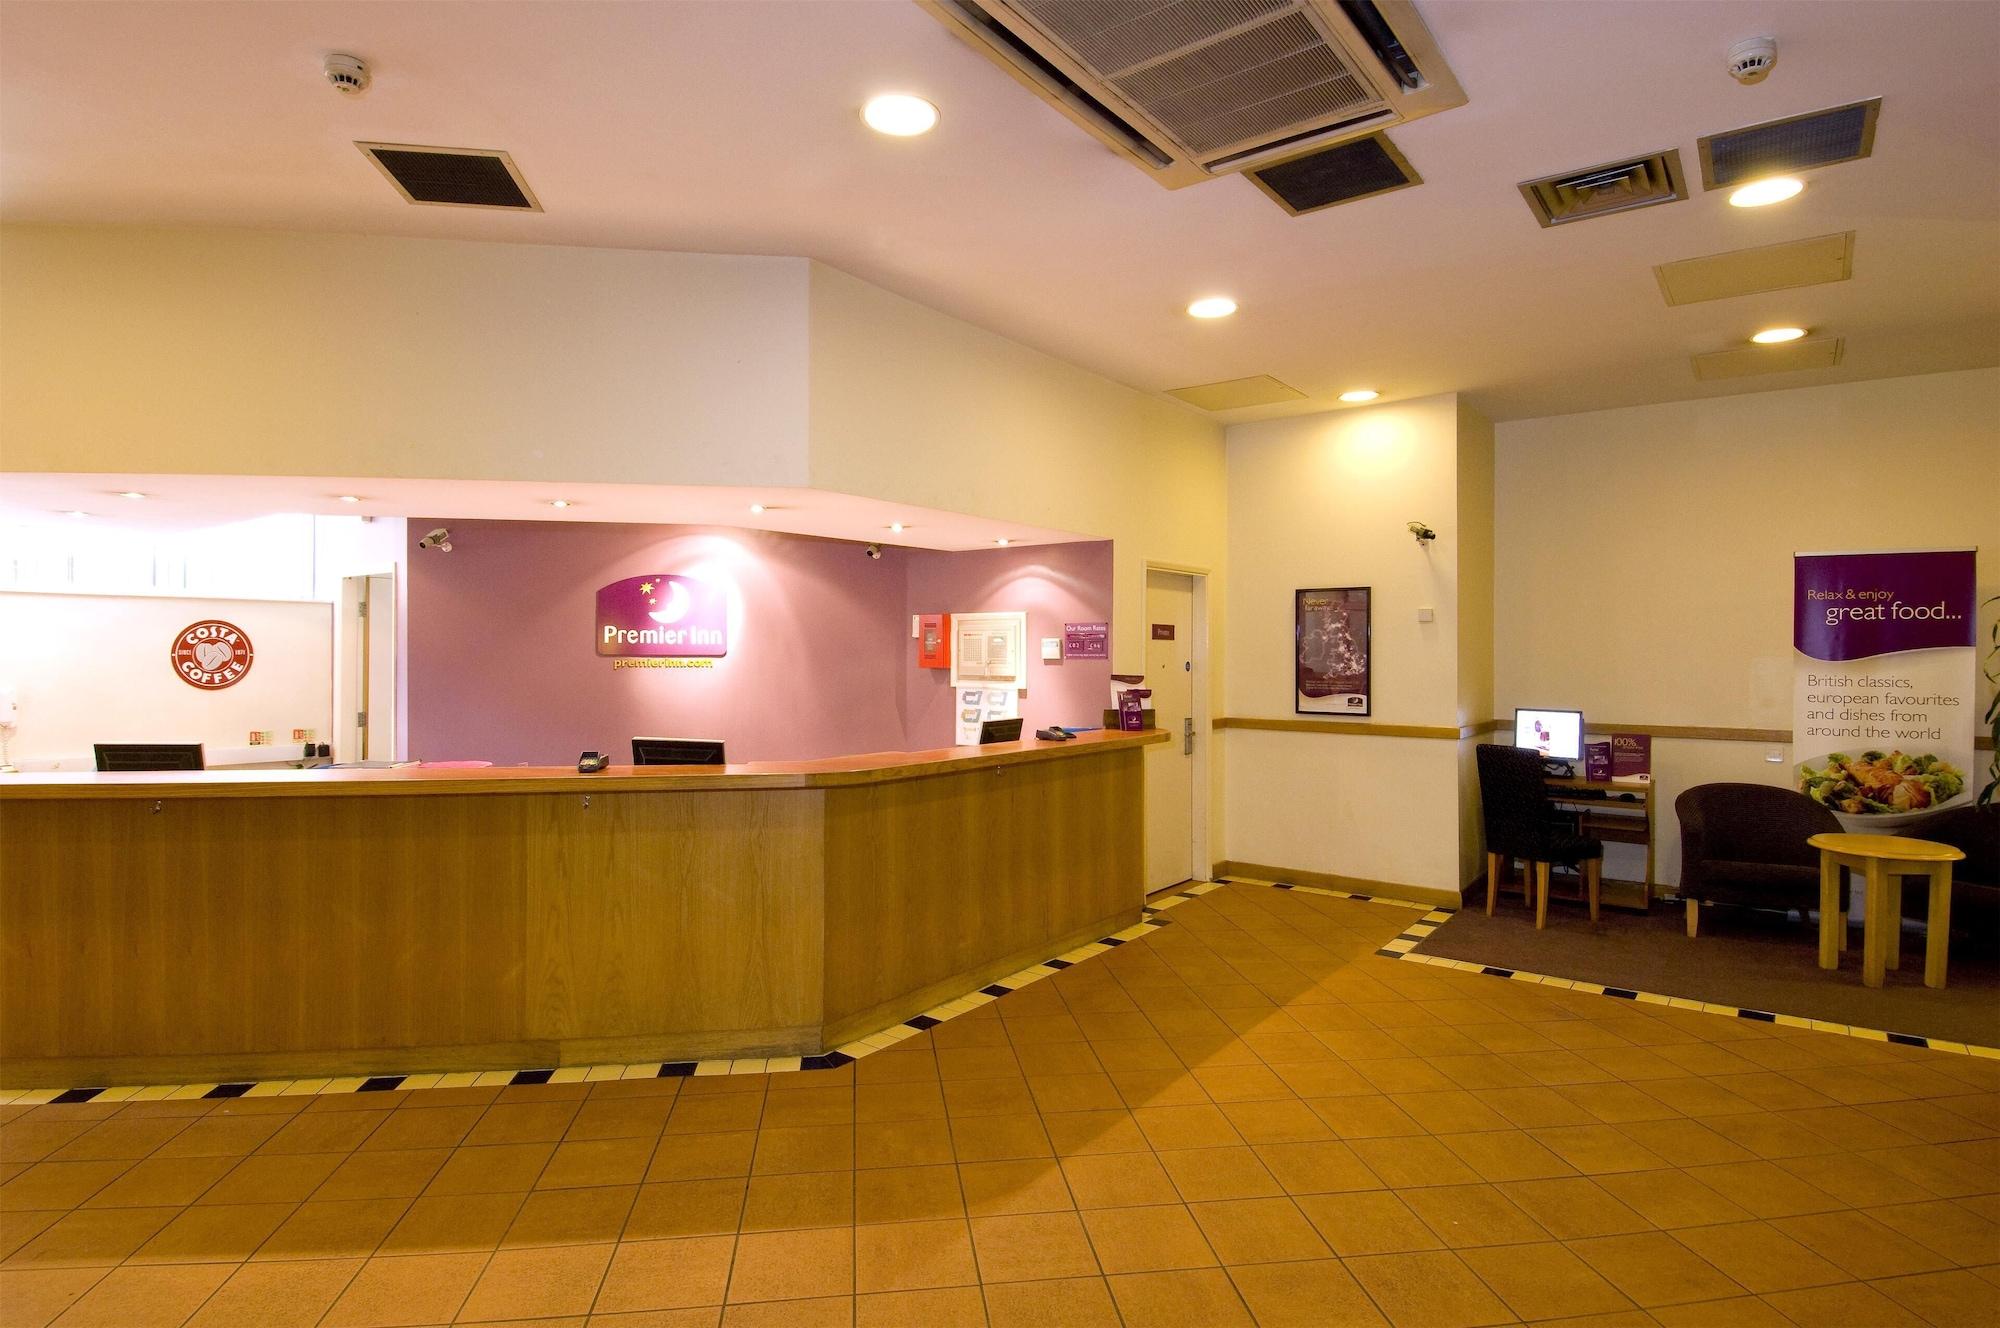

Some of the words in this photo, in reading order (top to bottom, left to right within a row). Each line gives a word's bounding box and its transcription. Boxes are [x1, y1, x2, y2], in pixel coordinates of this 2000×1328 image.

[1807, 589, 1843, 600] Relax
[1846, 589, 1856, 600] &
[1858, 588, 1894, 602] enjoy
[1825, 603, 1886, 626] great
[1891, 600, 1962, 620] food...
[186, 626, 238, 645] COSTA
[603, 625, 688, 645] Premier
[690, 625, 723, 645] Inn
[181, 661, 244, 684] COFFEE
[1807, 674, 1853, 688] British
[1857, 675, 1913, 689] classics,
[1807, 693, 1879, 707] european
[1884, 692, 1960, 706] favourites
[1806, 708, 1834, 720] and
[1839, 708, 1886, 721] dishes
[1891, 709, 1928, 722] from
[1806, 726, 1861, 738] around
[1866, 726, 1890, 738] the
[1895, 728, 1941, 740] world
[1614, 737, 1637, 746] 100%
